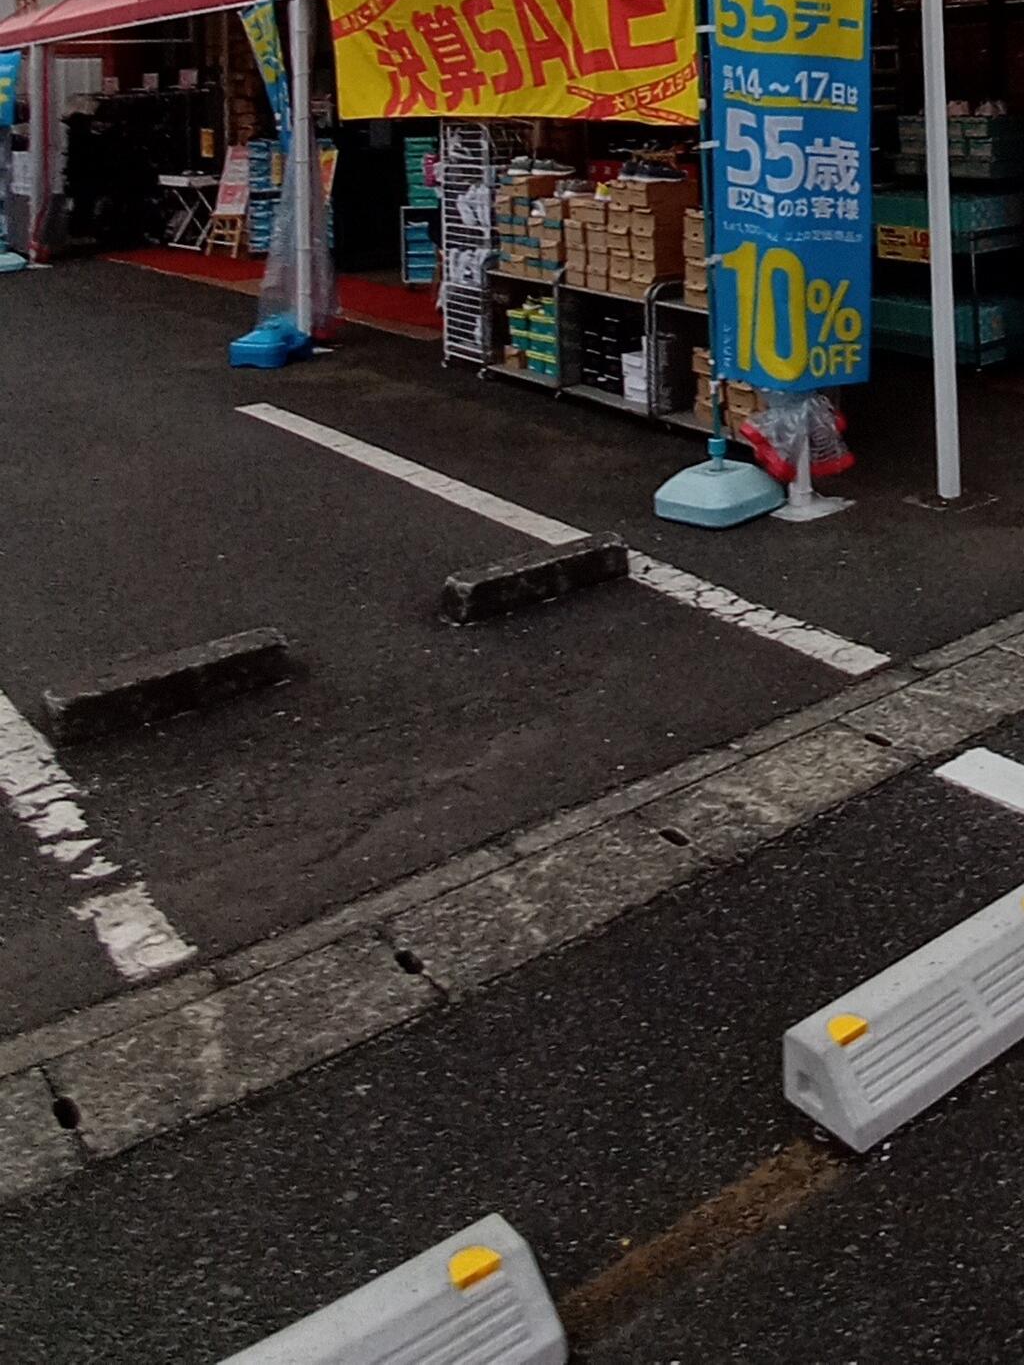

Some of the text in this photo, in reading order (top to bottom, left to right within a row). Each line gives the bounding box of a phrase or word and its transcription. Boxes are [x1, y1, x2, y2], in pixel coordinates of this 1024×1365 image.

[725, 108, 861, 194] 55歳
[722, 241, 862, 381] 10%
[809, 344, 862, 377] OFF
